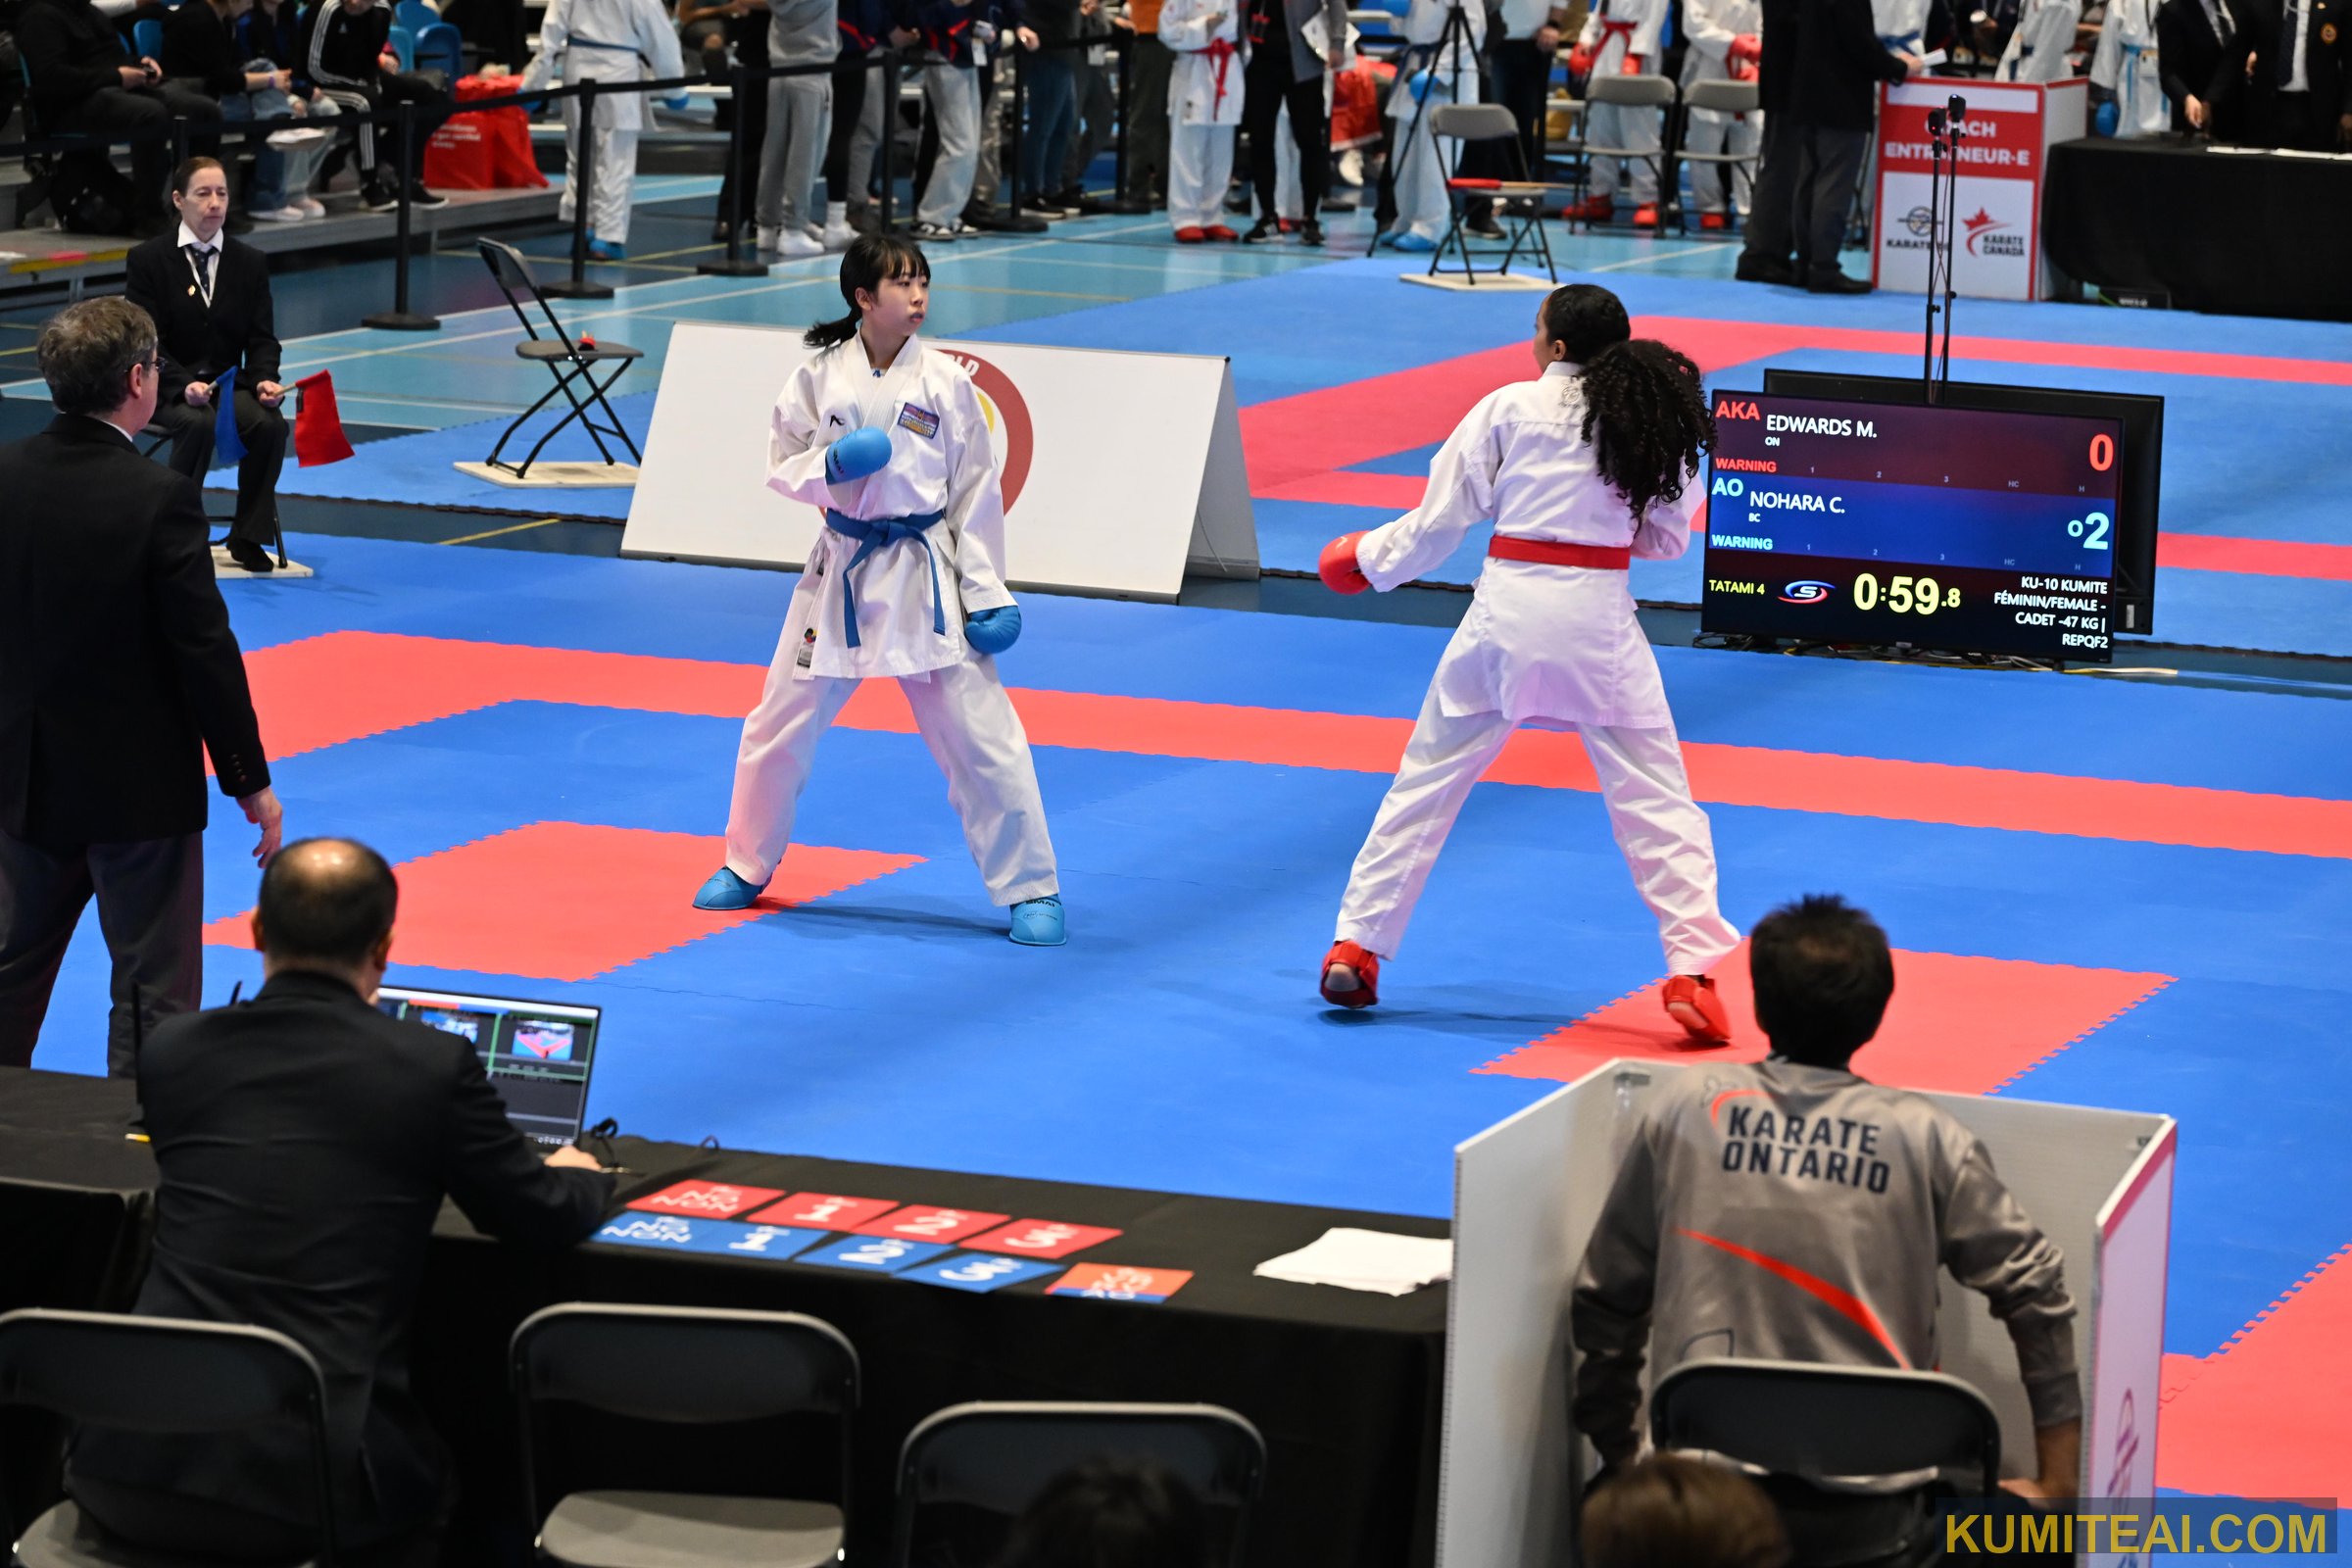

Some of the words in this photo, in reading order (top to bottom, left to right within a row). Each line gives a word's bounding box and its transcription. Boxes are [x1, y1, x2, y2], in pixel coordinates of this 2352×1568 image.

[1925, 120, 1996, 137] ACH
[1983, 234, 2024, 245] KARATE
[1983, 245, 2025, 256] CANADA
[1716, 401, 1760, 420] AKA
[1767, 415, 1852, 436] EDWARDS
[1856, 420, 1878, 438] M.
[1765, 436, 1780, 447] ON
[2088, 433, 2114, 471] 0
[1716, 458, 1777, 473] WARNING
[1711, 477, 1744, 497] AO
[1749, 490, 1826, 513] NOHARA
[1829, 497, 1845, 514] C.
[1748, 513, 1761, 522] BC
[1711, 534, 1773, 551] WARNING
[2004, 558, 2015, 566] HC
[1708, 579, 1754, 595] TATAMI
[1756, 584, 1765, 595] 4
[1853, 573, 1961, 615] 0:59.8
[2021, 576, 2058, 591] KU-10
[2061, 579, 2108, 594] KUMITE
[1993, 589, 2098, 612] FÉMININ/FEMALE
[2015, 612, 2056, 626] CADET
[2058, 615, 2079, 628] -47
[2081, 616, 2099, 630] KG
[2062, 633, 2108, 649] REPQF2
[1729, 1105, 1881, 1156] KARATE
[1722, 1141, 1890, 1195] ONTARIO
[793, 1203, 841, 1222] 1
[893, 1215, 958, 1236] 2
[728, 1232, 774, 1251] 1
[1004, 1227, 1068, 1249] 3
[839, 1243, 906, 1264] 2
[938, 1261, 1011, 1282] 3
